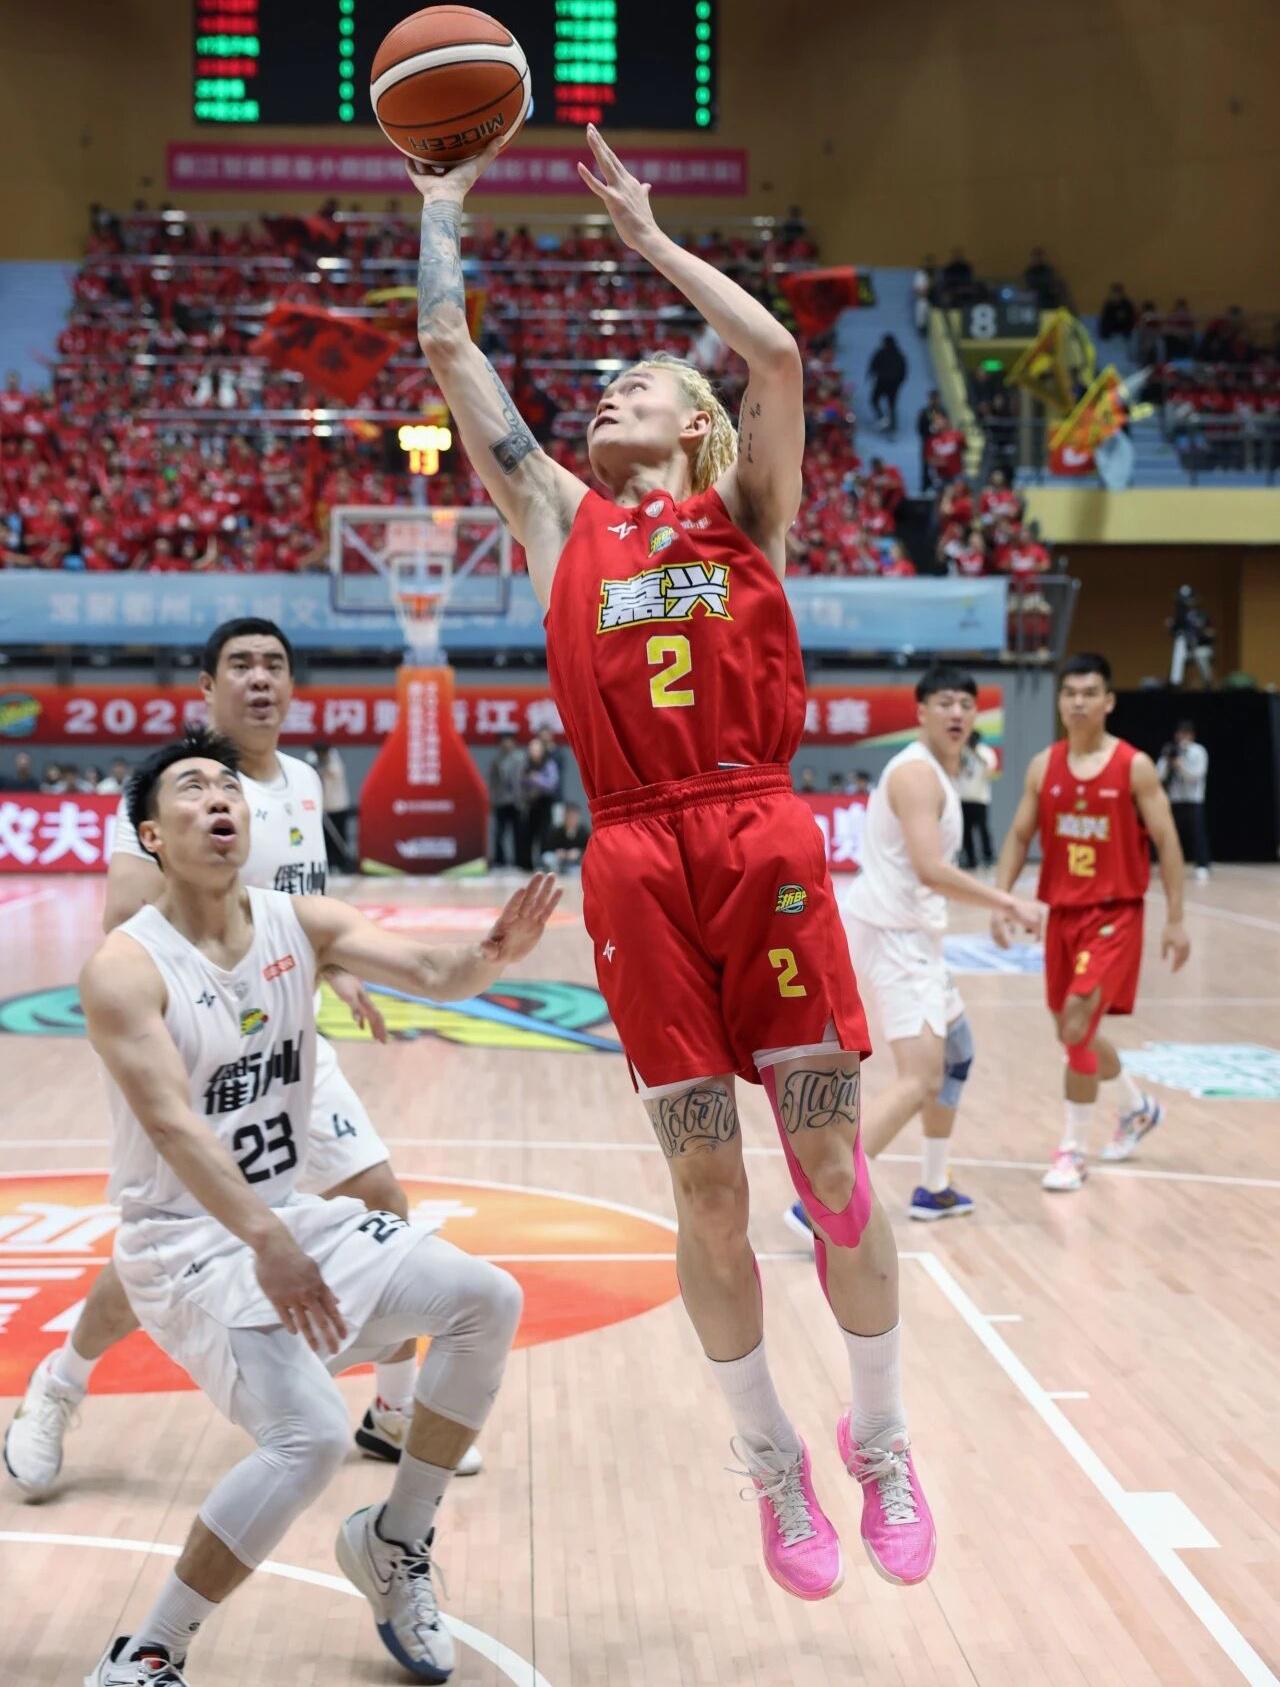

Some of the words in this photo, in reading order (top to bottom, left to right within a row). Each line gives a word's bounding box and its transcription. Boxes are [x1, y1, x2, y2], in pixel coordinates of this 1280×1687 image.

[969, 303, 998, 338] 8
[597, 561, 734, 634] 嘉兴
[646, 635, 695, 708] 2
[0, 801, 116, 865] 农夫
[1067, 843, 1096, 877] 12
[767, 948, 808, 998] 2
[202, 1030, 304, 1115] 衢州
[232, 1111, 298, 1185] 23
[331, 1113, 357, 1139] 4
